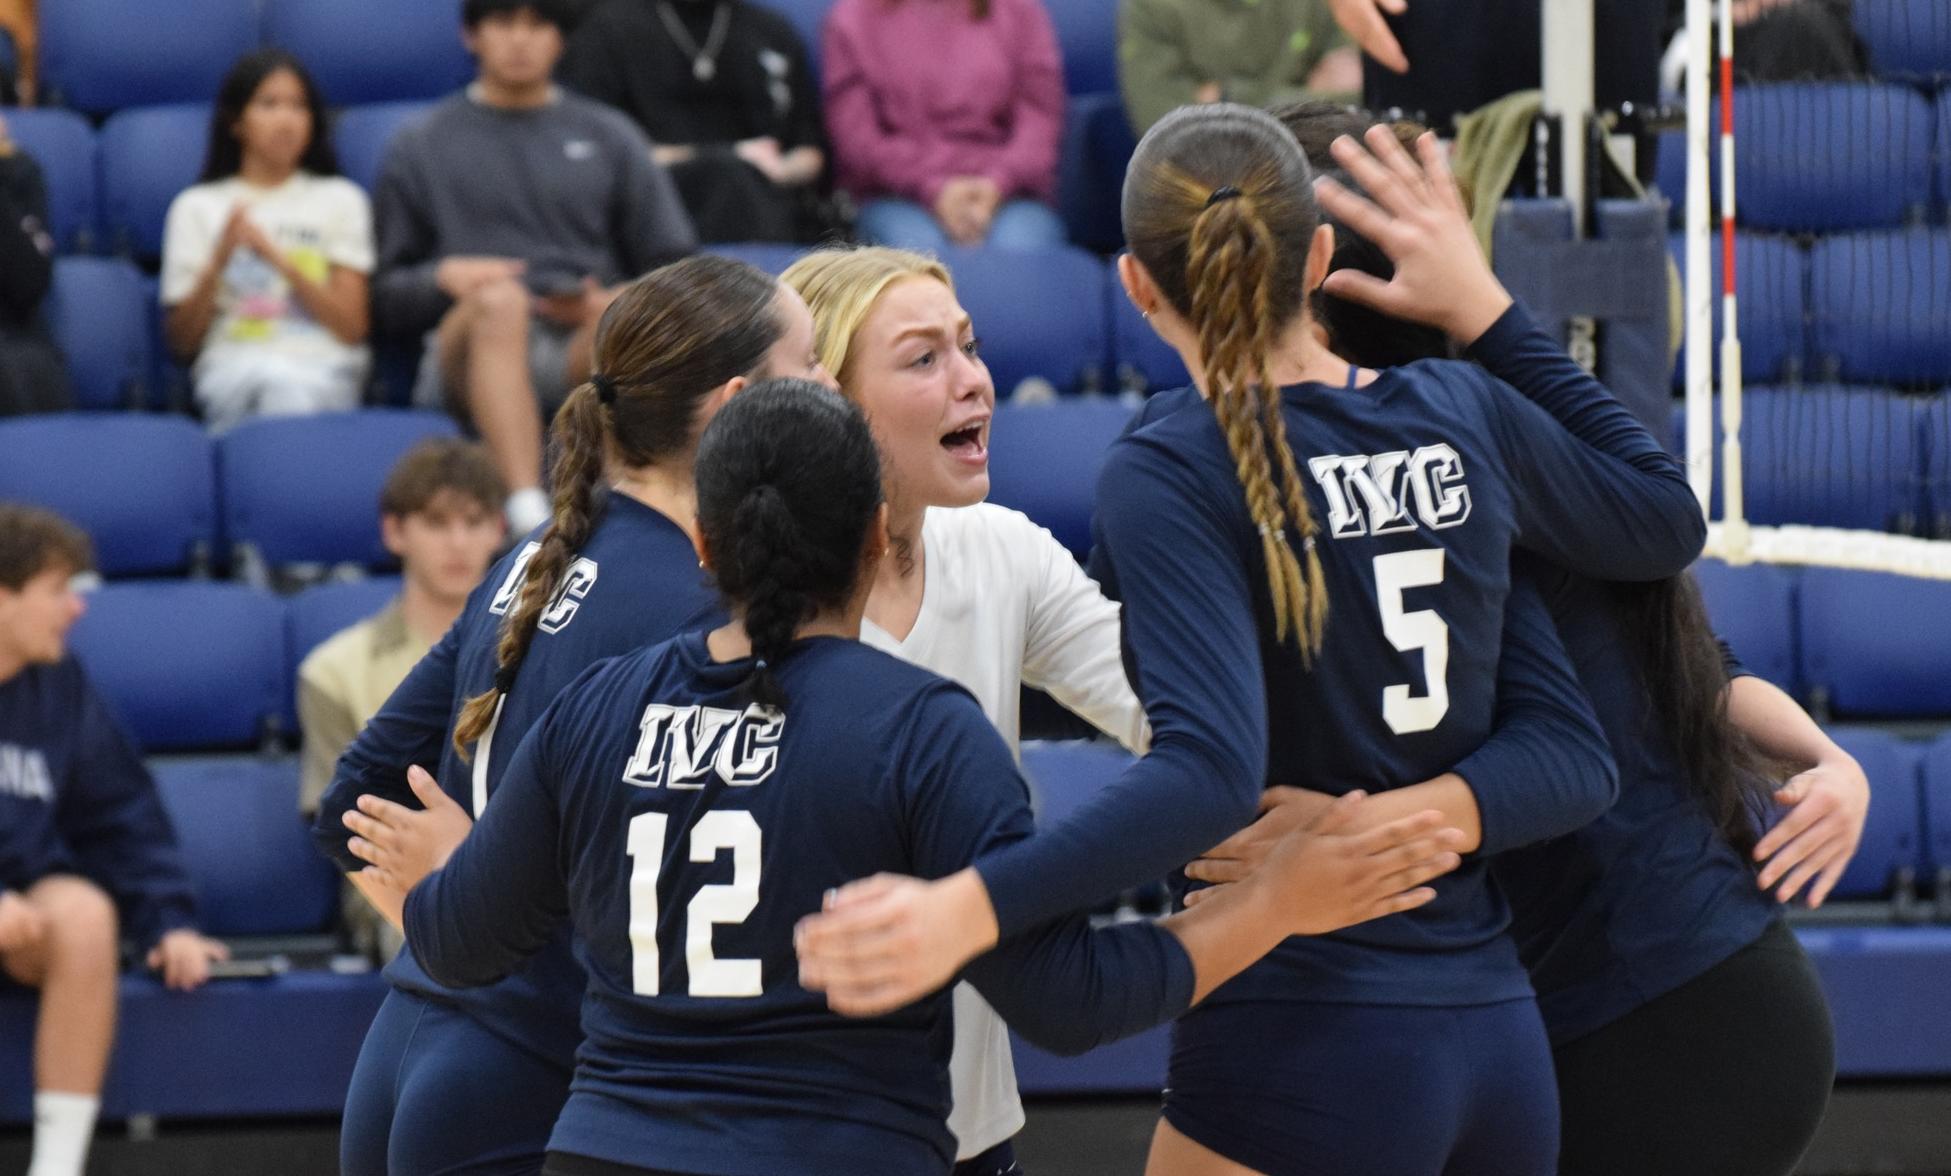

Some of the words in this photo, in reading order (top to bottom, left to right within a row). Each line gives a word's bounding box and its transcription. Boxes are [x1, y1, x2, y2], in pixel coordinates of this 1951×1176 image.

[1307, 442, 1473, 540] IVC
[489, 540, 599, 635] IC
[1372, 547, 1450, 736] 5
[621, 702, 787, 790] IVC
[625, 810, 764, 998] 12
